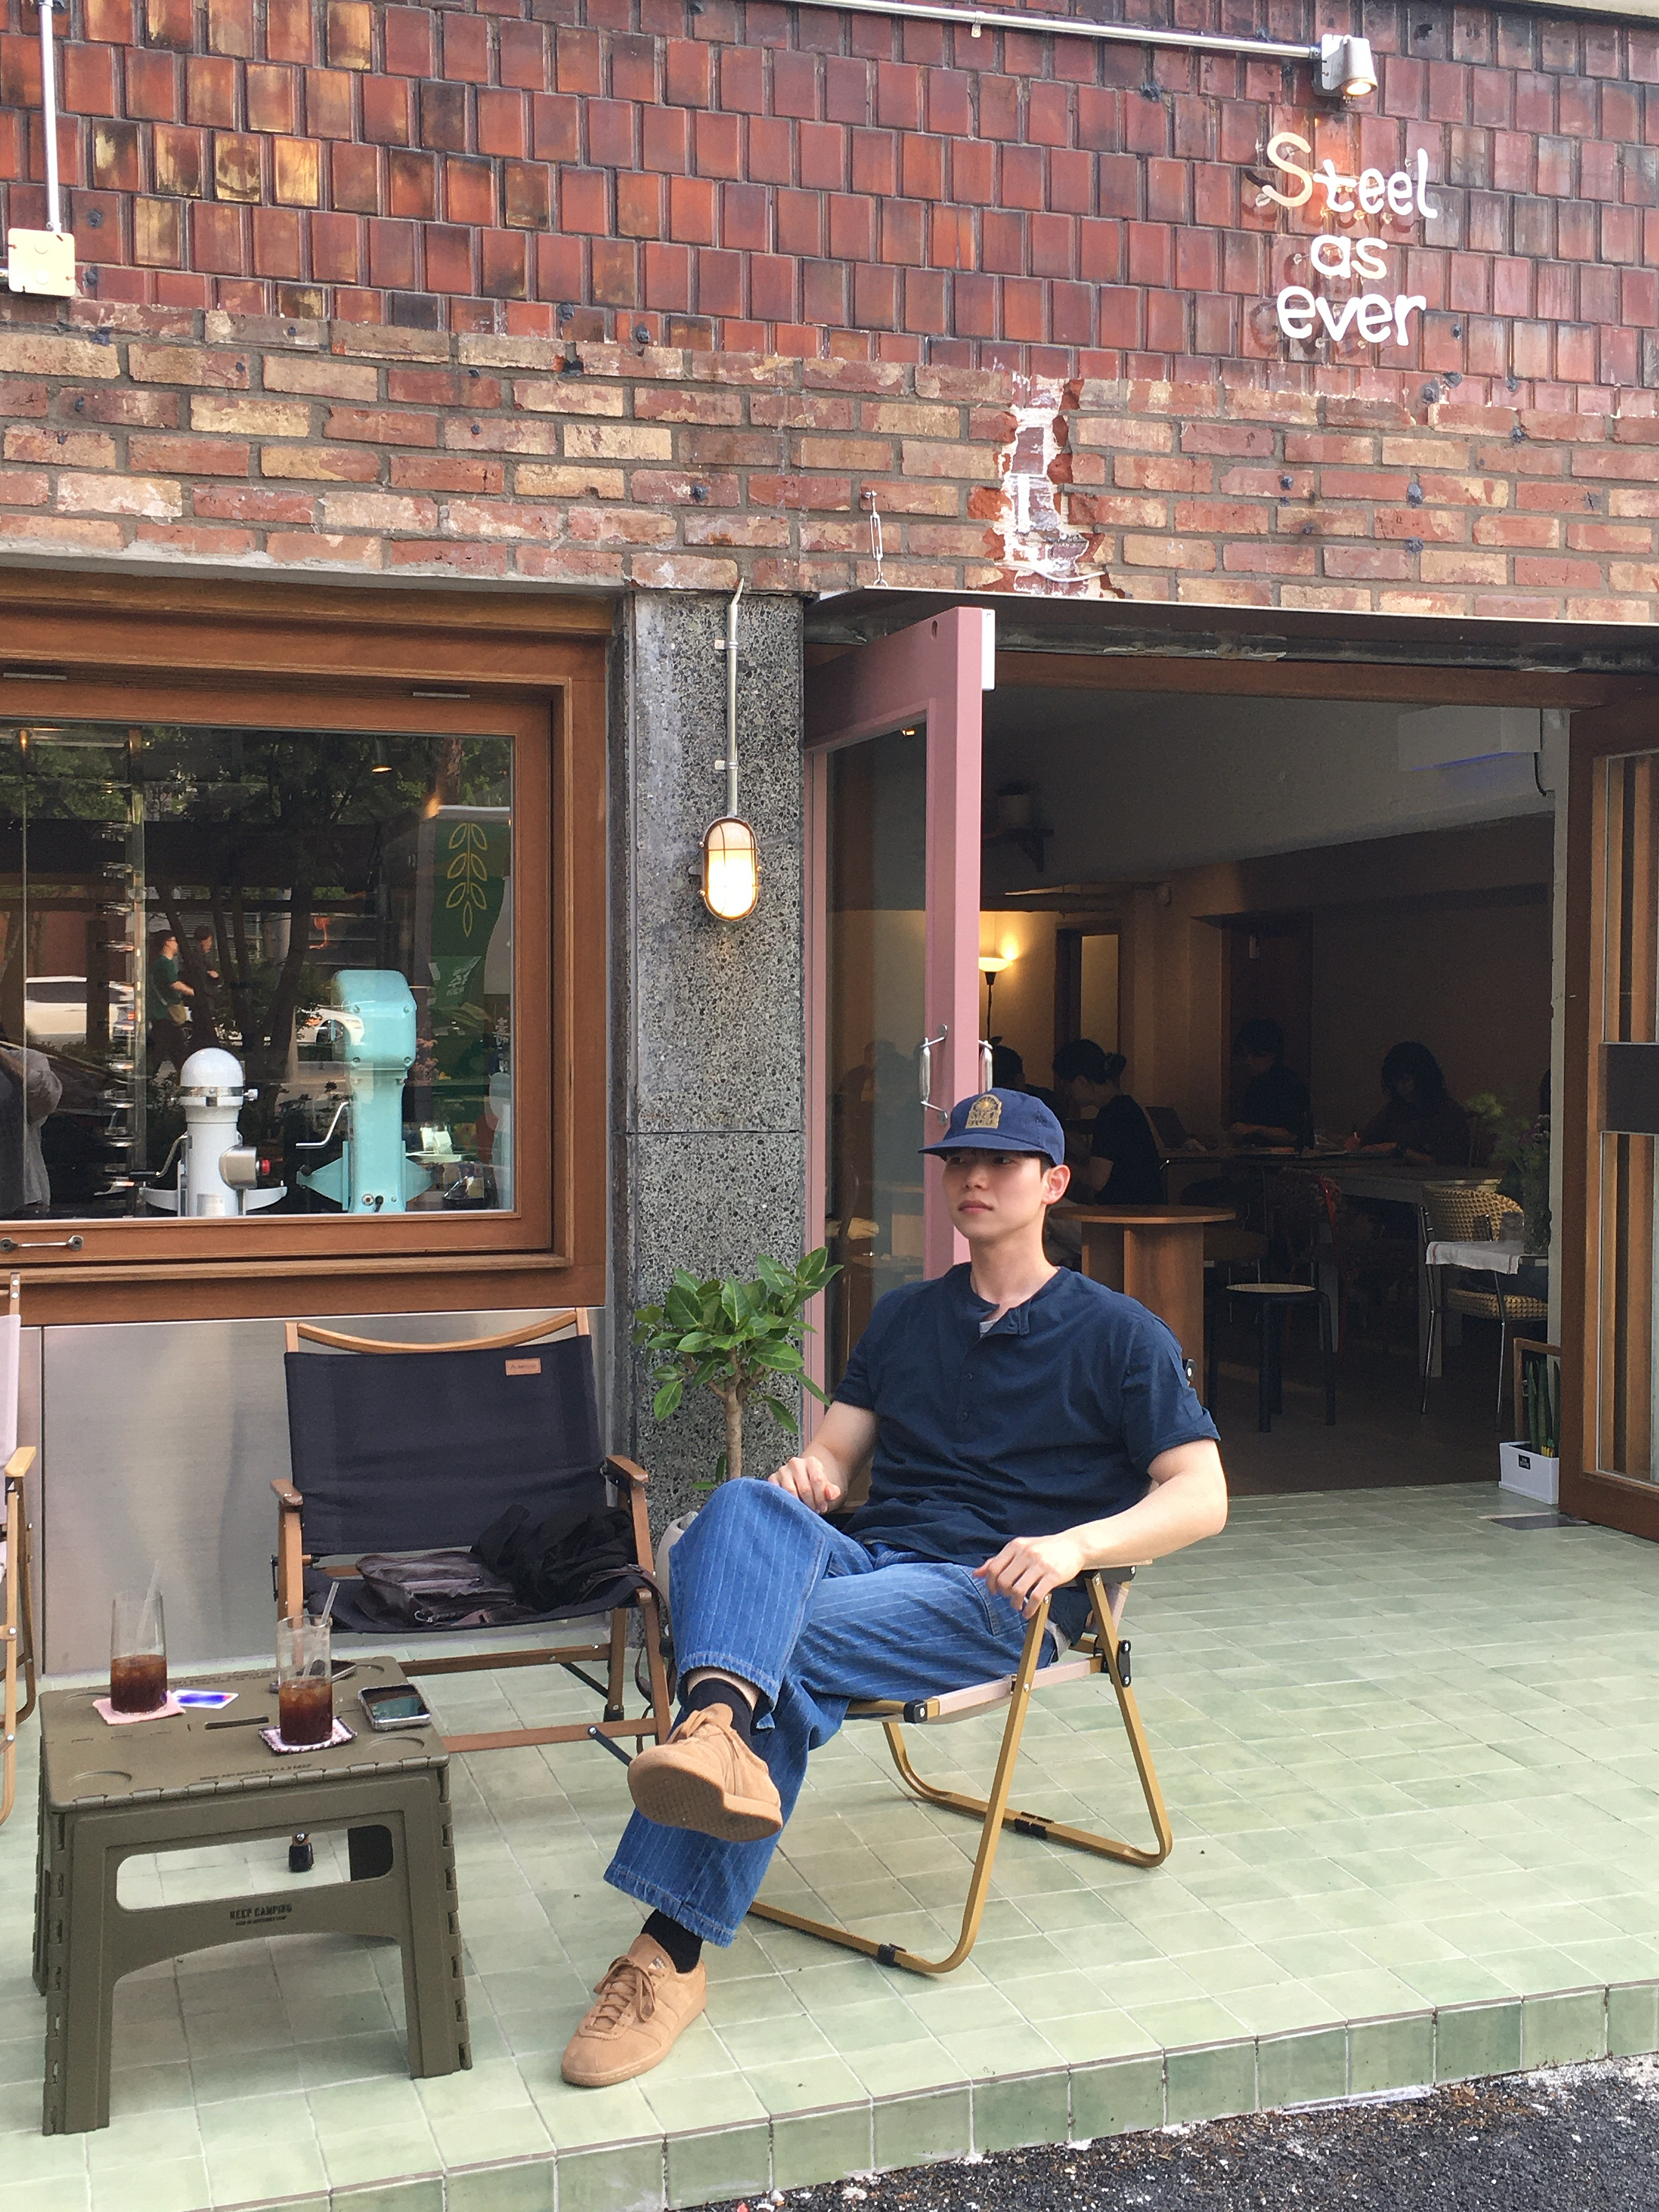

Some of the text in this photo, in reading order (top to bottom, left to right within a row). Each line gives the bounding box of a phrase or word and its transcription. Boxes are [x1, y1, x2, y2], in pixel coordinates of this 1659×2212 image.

[1262, 132, 1438, 218] Steel
[1311, 234, 1389, 280] as
[1277, 285, 1426, 346] ever
